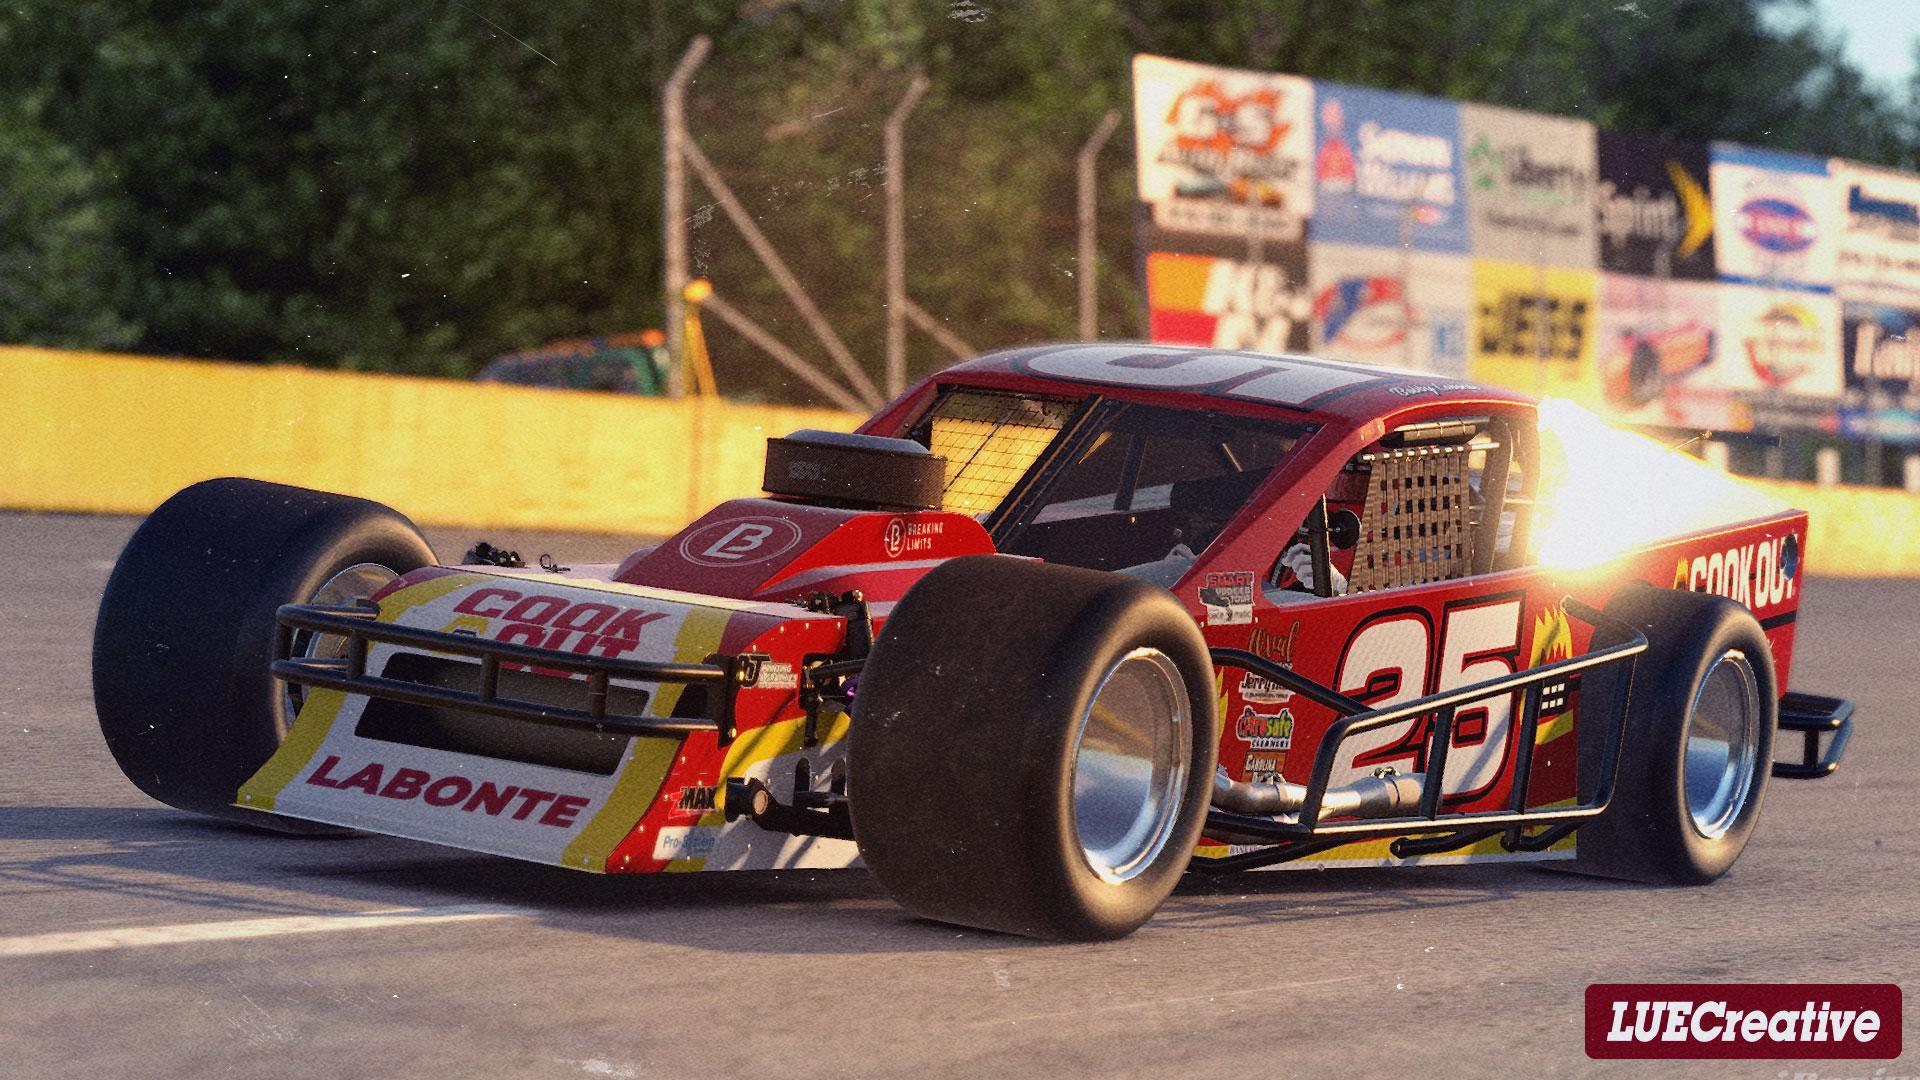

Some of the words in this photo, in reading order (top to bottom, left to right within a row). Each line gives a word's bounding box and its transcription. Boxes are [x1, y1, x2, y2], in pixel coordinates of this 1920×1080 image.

[906, 537, 932, 551] LIMITS
[907, 521, 943, 536] BREAKING
[1209, 575, 1252, 588] SMART
[1689, 544, 1755, 611] COOK
[453, 587, 671, 642] COOK
[495, 623, 641, 684] OUT
[1325, 592, 1524, 802] 25
[305, 755, 591, 829] LABONTE
